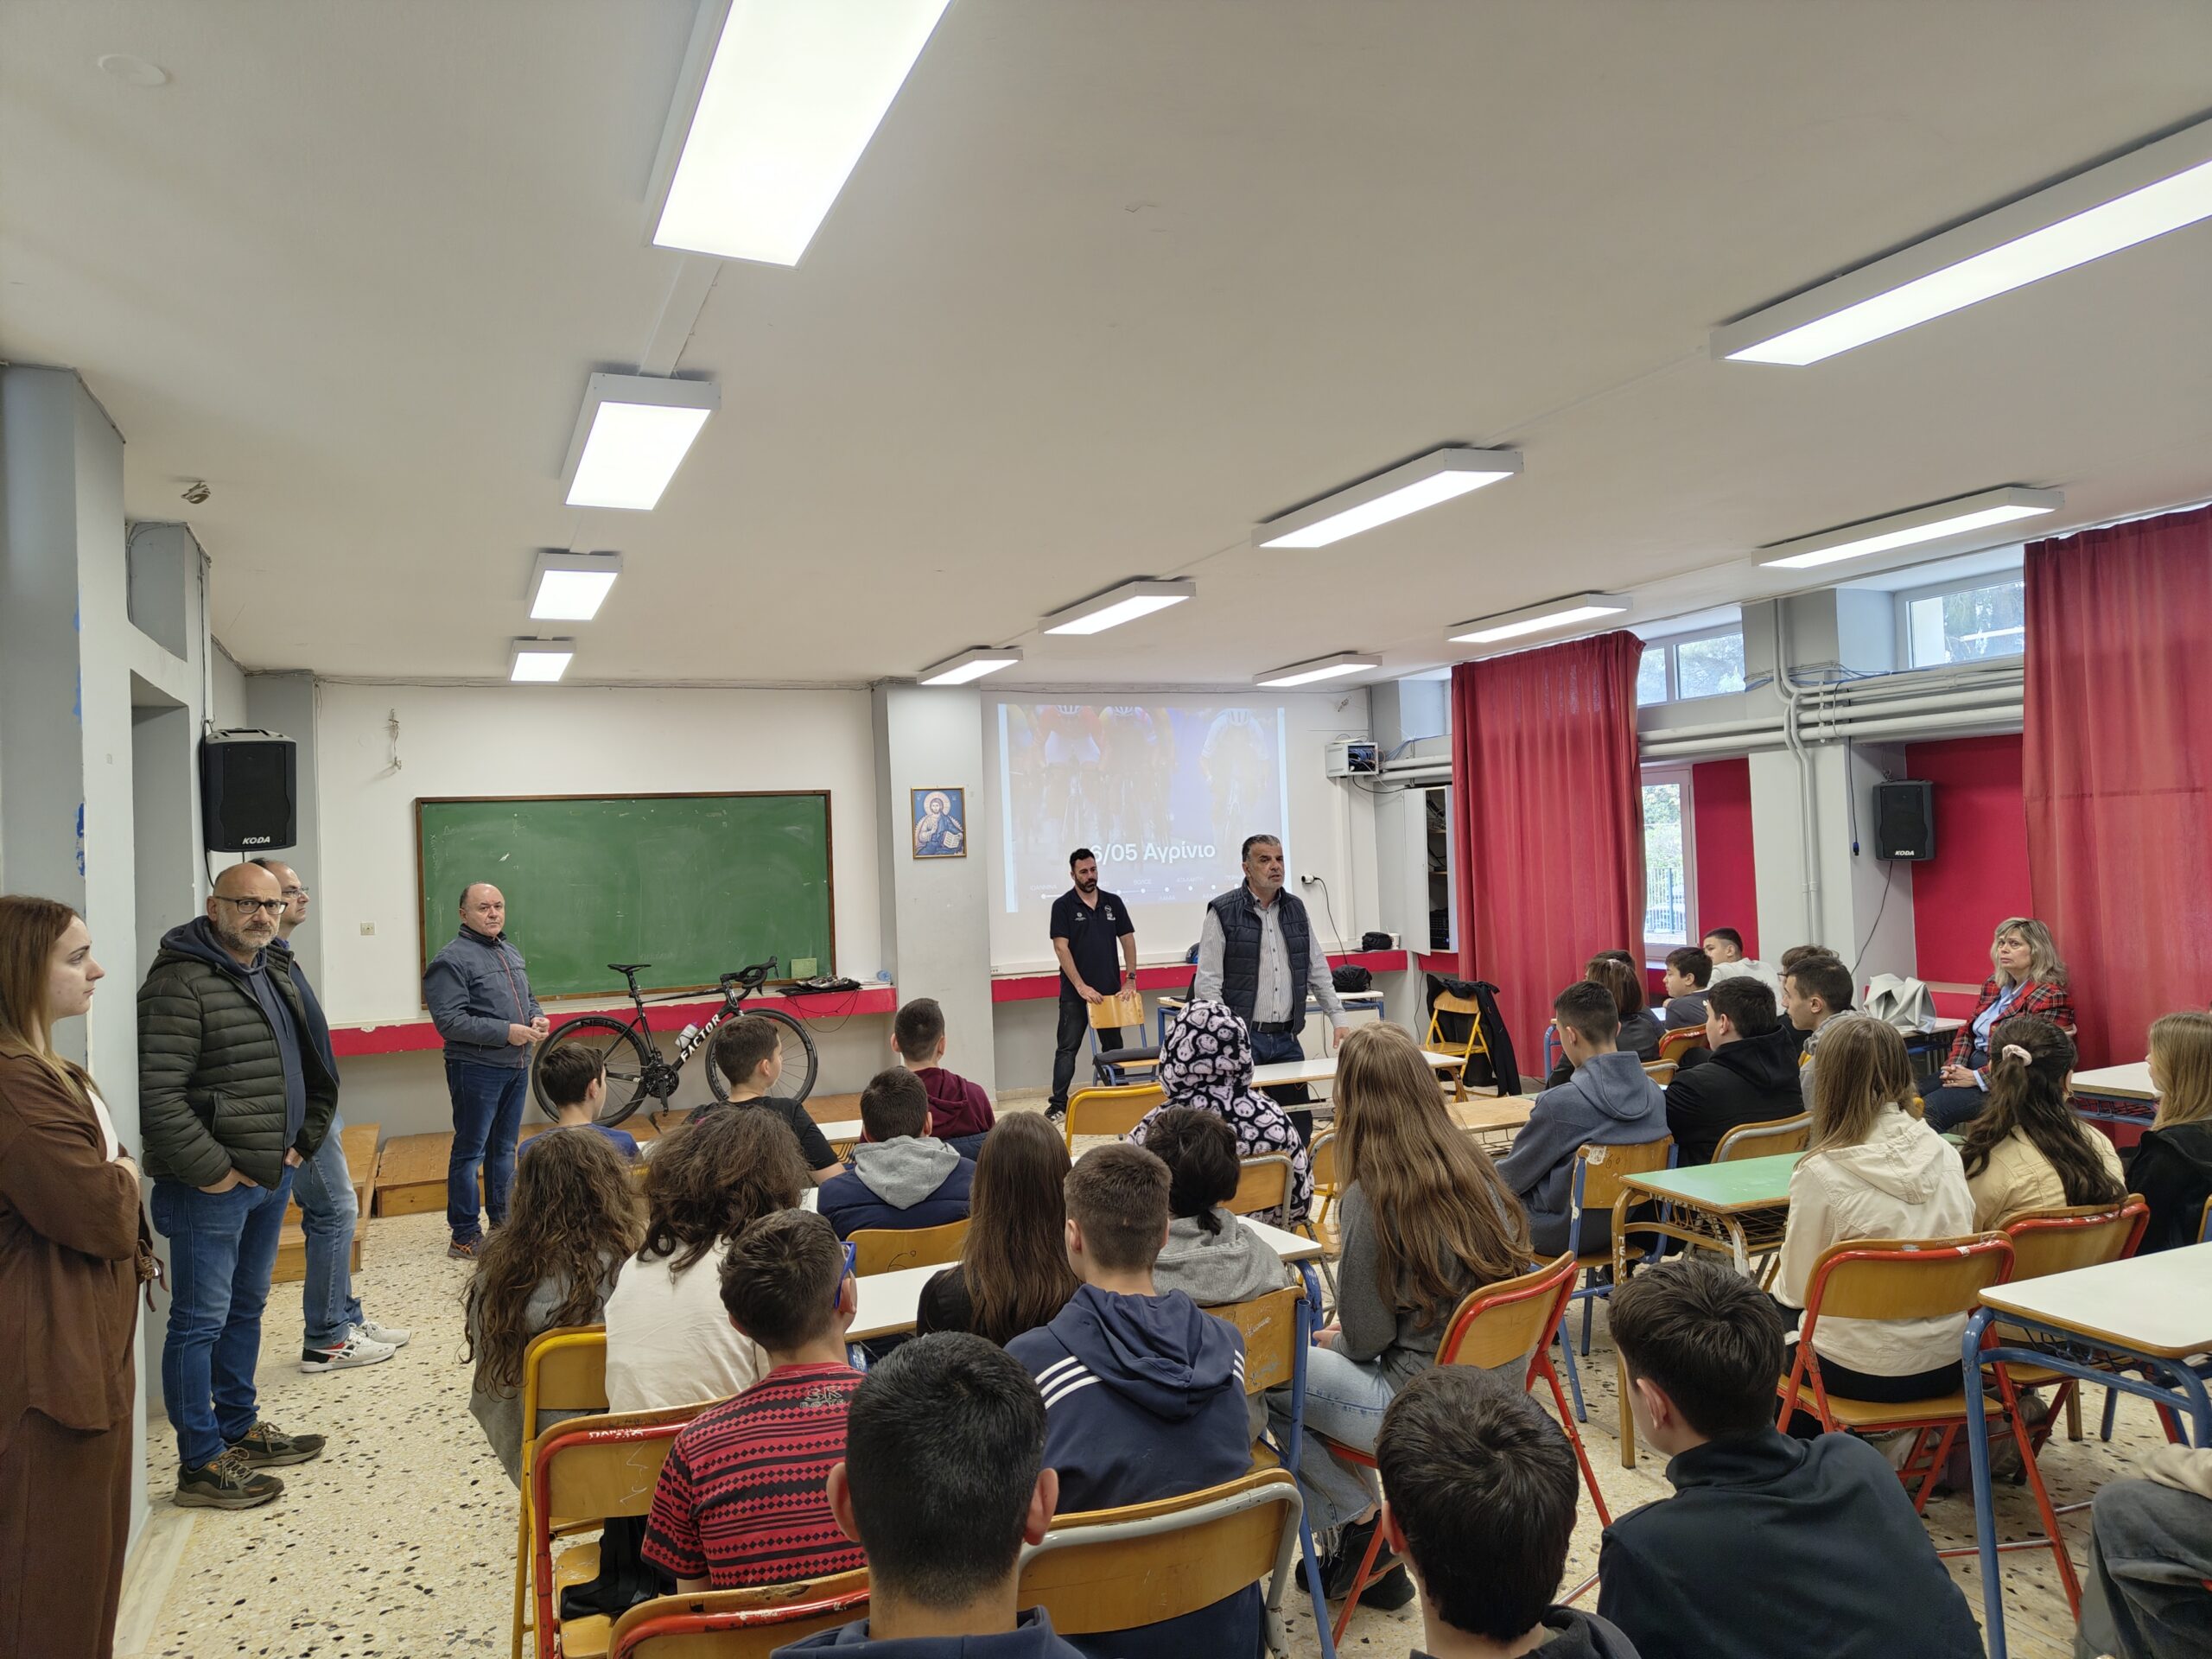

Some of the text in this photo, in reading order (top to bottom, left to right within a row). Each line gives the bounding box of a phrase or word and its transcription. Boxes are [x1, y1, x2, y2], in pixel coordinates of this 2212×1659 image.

[242, 836, 270, 845] KODA
[1143, 841, 1216, 863] Αγρίνιο
[680, 1014, 721, 1063] FACTOR
